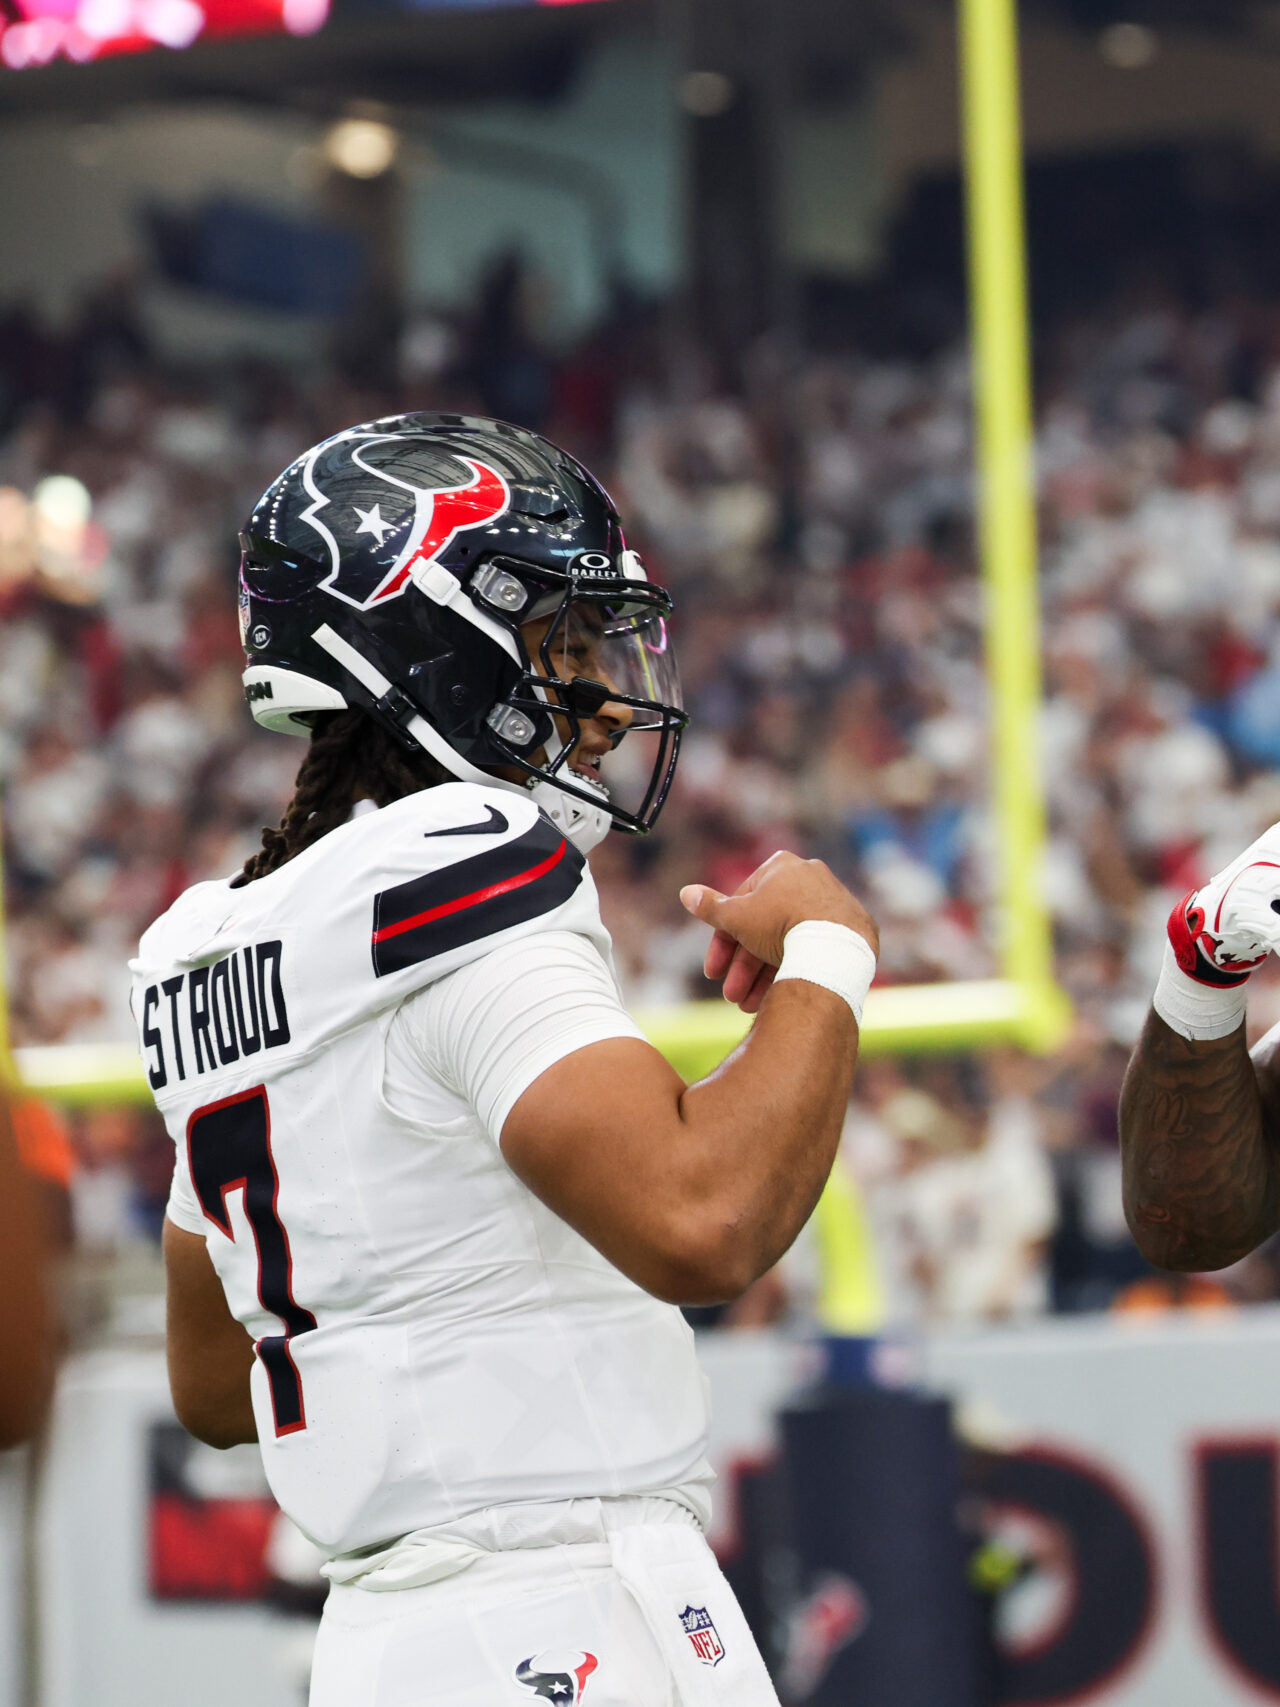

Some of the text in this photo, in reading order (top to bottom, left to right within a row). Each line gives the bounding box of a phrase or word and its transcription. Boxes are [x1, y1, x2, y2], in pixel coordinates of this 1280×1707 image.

[571, 568, 617, 578] OAKLEY
[245, 681, 274, 702] ON
[143, 939, 291, 1091] STROUD
[186, 1083, 318, 1438] 7
[687, 1629, 721, 1661] NFL
